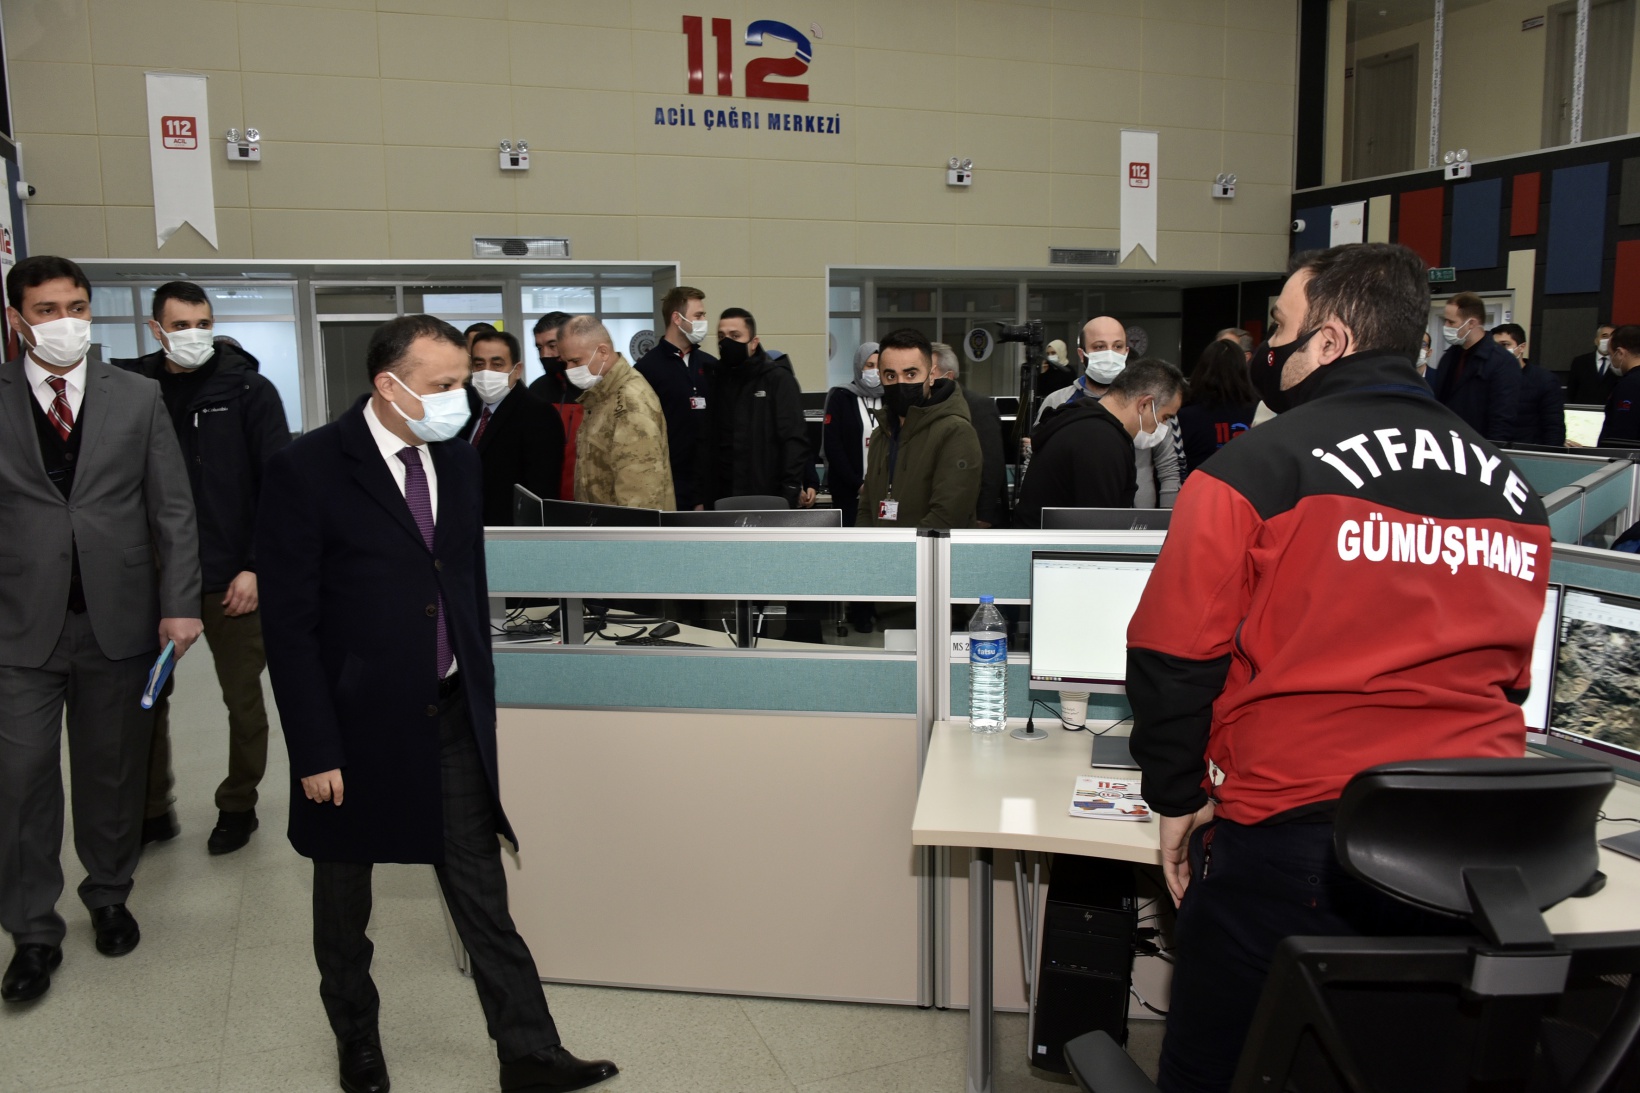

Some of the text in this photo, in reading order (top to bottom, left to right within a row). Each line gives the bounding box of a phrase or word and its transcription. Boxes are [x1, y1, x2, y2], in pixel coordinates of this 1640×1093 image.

[682, 15, 812, 102] 112
[166, 120, 192, 136] 112
[654, 104, 841, 134] ACİL ÇAĞRI MERKEZİ
[1132, 165, 1147, 177] 112
[1312, 428, 1530, 516] İTFAİYE
[1337, 512, 1538, 582] GÜMÜŞHANE
[952, 642, 964, 652] MS
